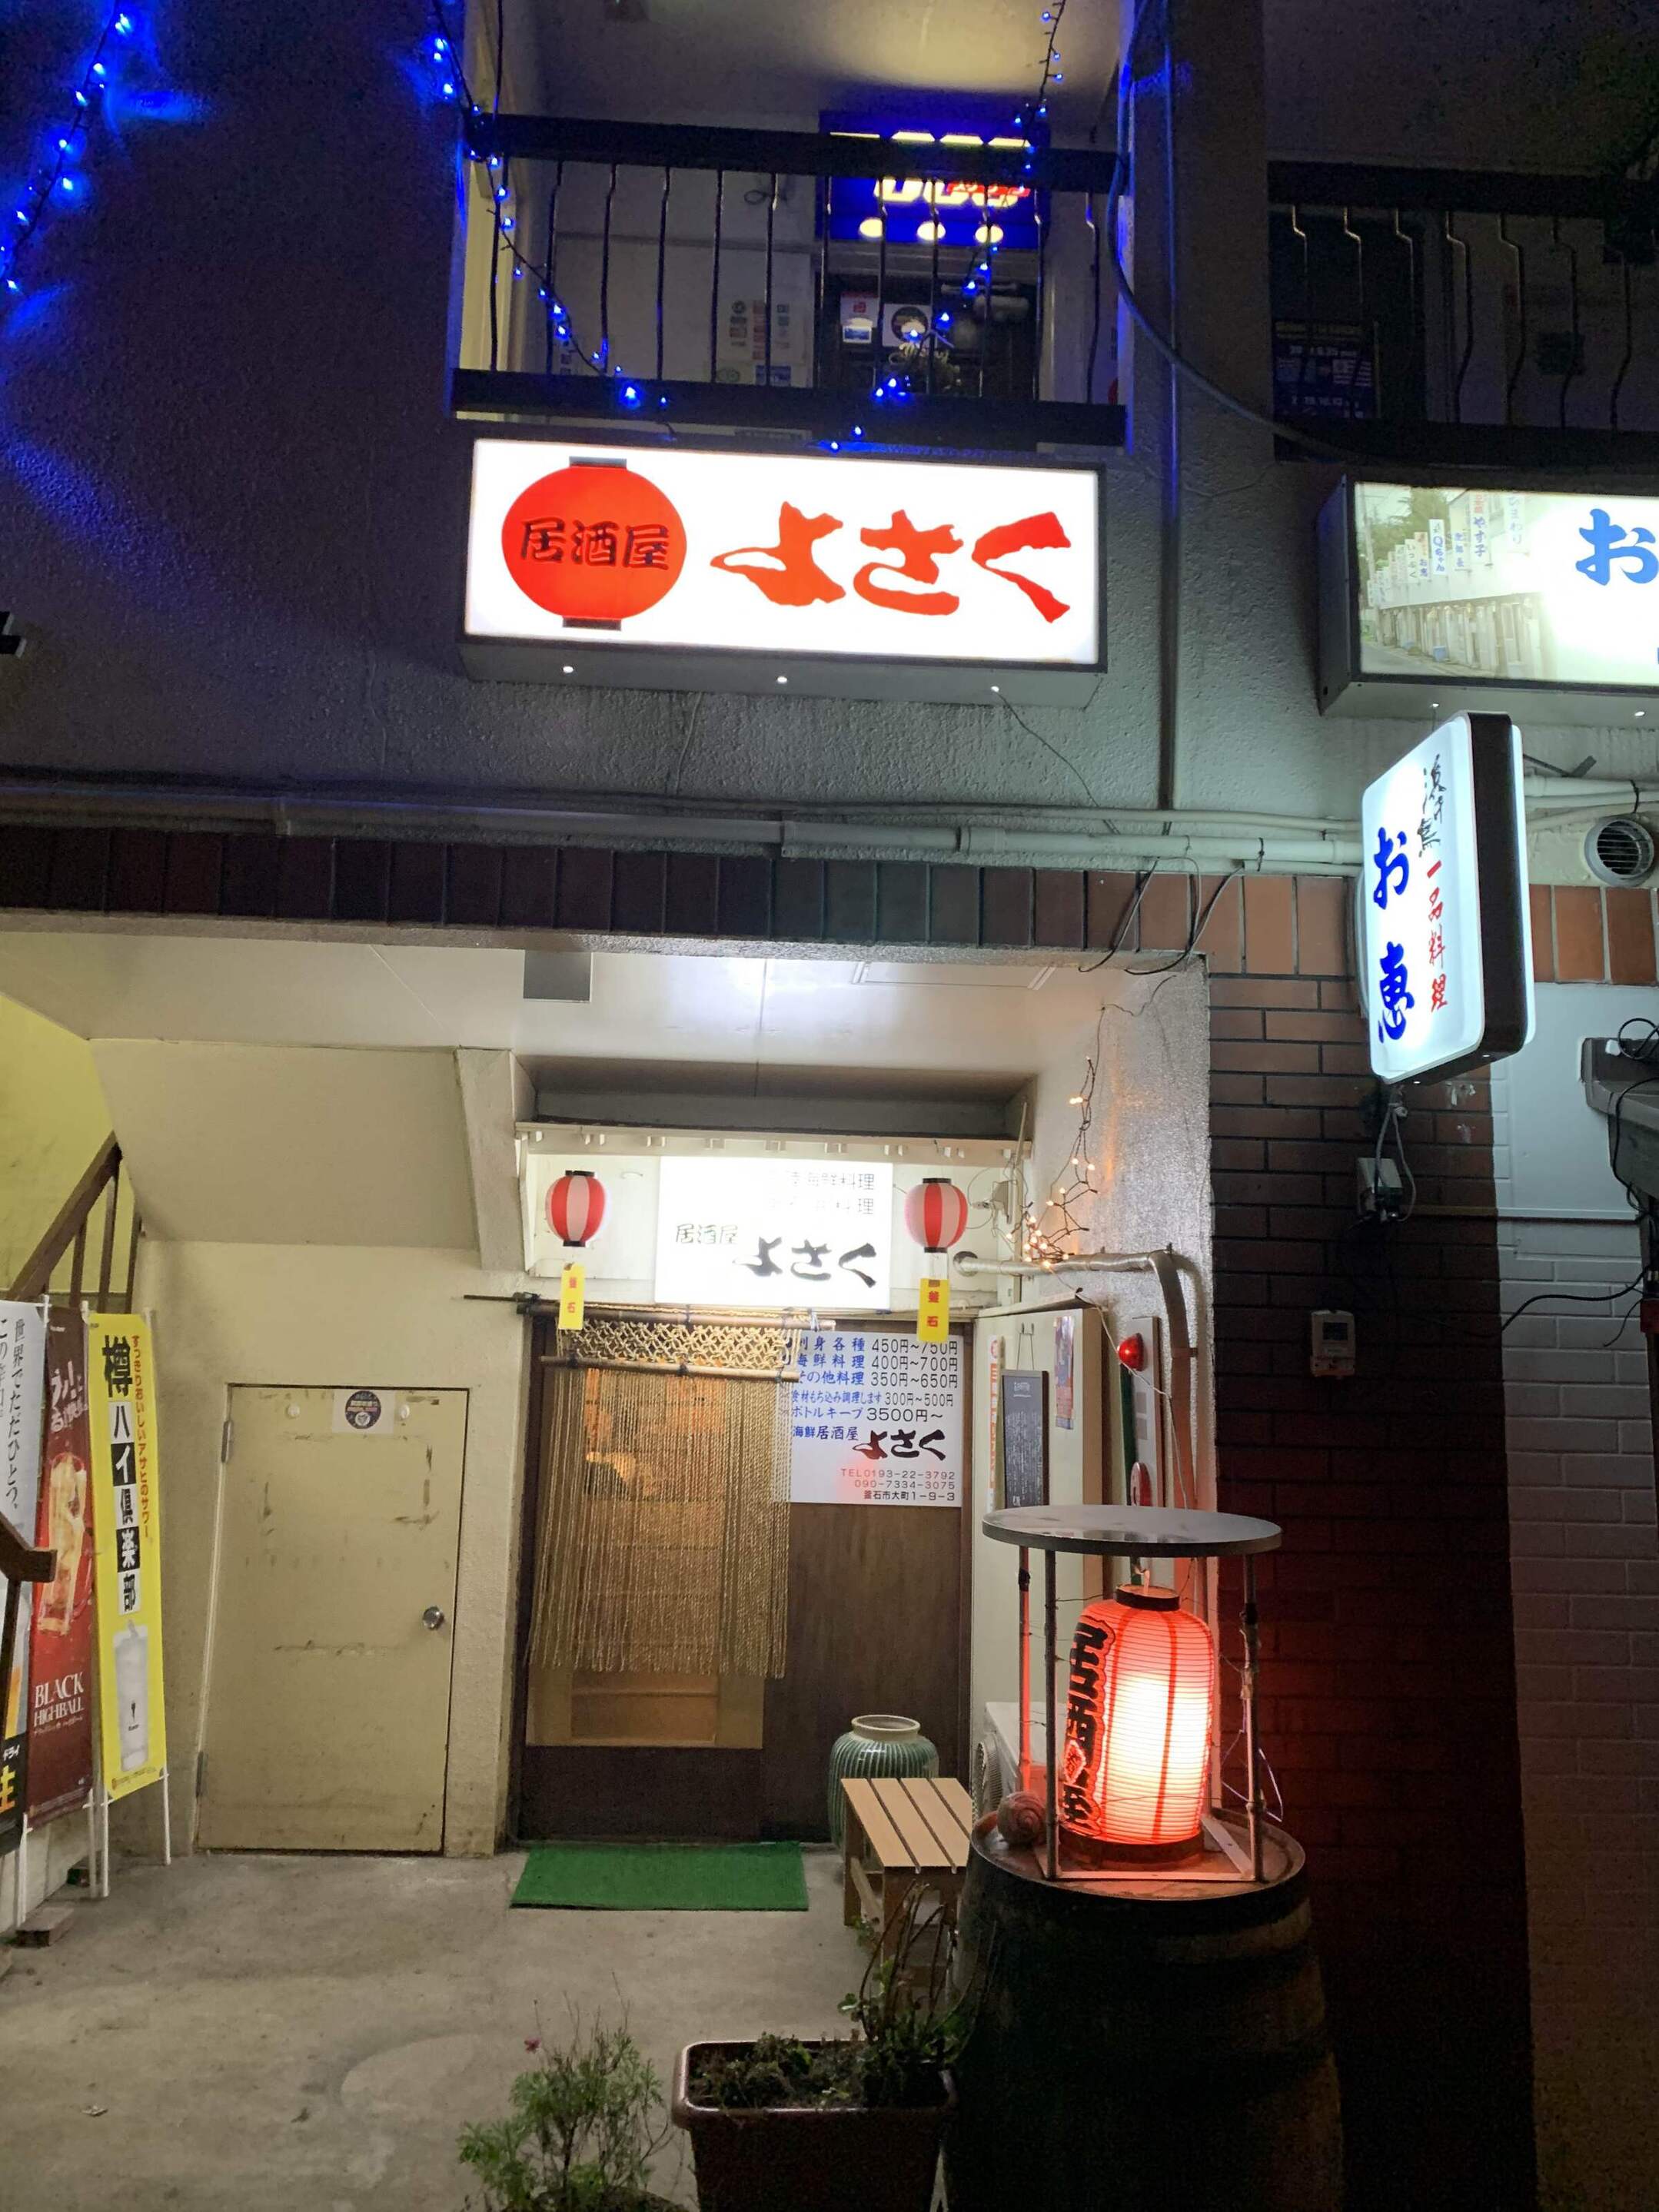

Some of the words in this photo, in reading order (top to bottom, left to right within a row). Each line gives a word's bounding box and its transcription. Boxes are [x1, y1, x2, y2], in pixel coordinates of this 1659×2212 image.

[520, 518, 670, 572] 居酒屋
[709, 500, 1072, 623] よさく
[1575, 508, 1659, 586] お
[1373, 825, 1415, 1045] お恵
[1427, 860, 1450, 1015] 一品料理
[675, 1223, 739, 1245] 居酒屋
[732, 1236, 877, 1289] よさく
[101, 1335, 138, 1613] 樽ハイ倶楽部
[852, 1429, 946, 1461] よさく
[34, 1696, 84, 1727] HIGHBALL
[35, 1672, 84, 1708] BLACK
